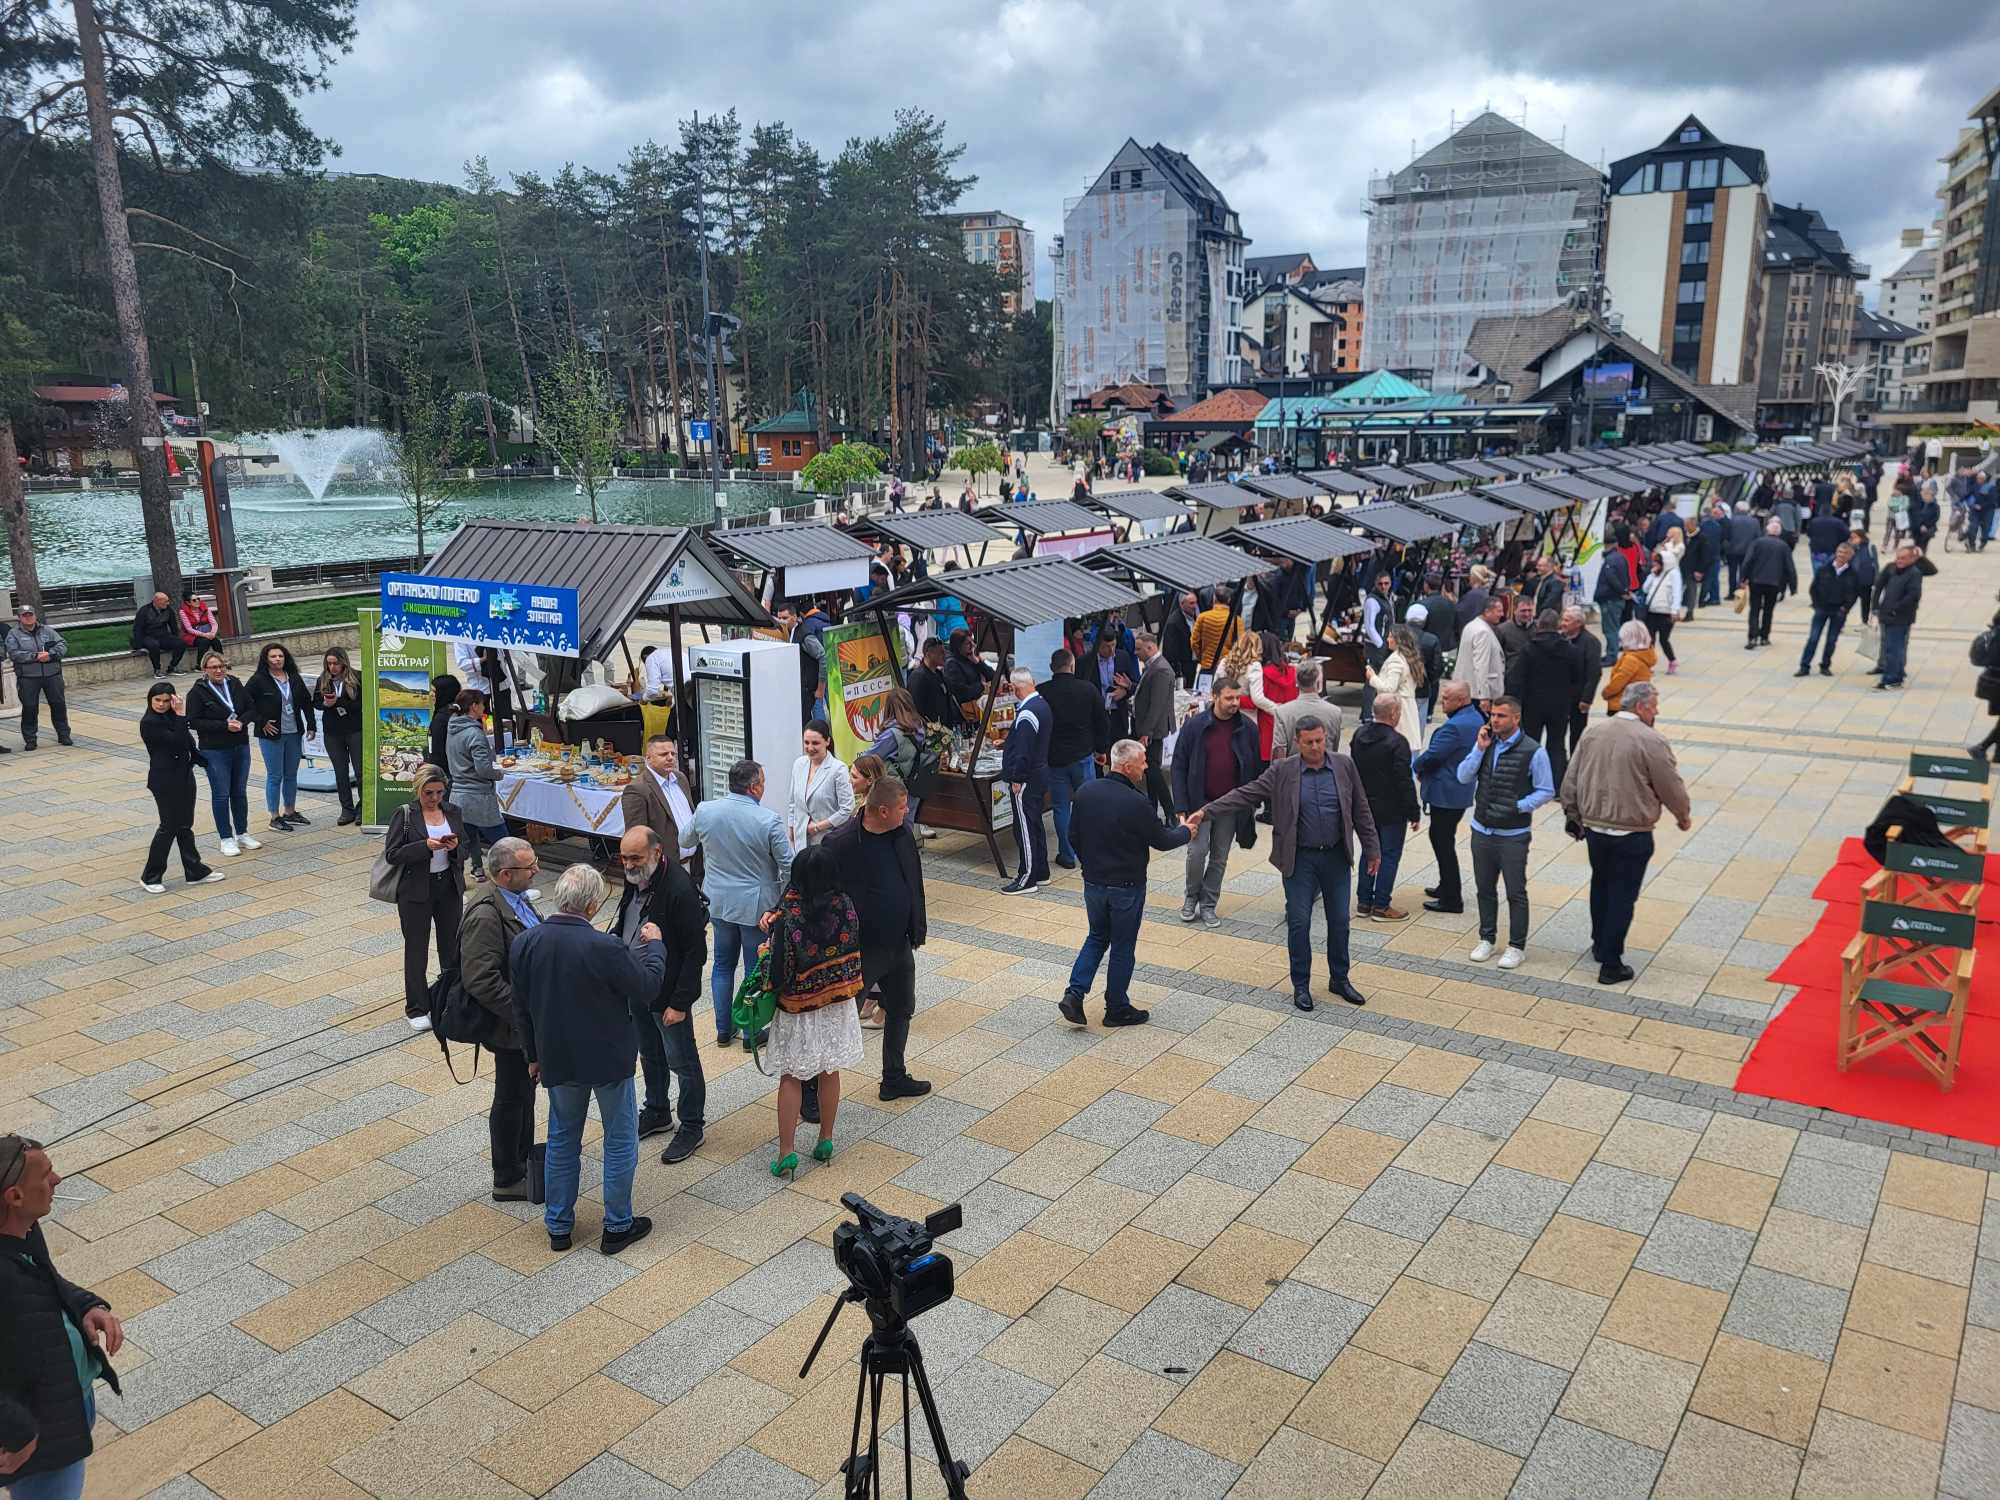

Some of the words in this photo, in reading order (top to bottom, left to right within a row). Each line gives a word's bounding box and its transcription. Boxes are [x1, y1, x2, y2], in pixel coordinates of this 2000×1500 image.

[531, 596, 558, 610] НАША
[527, 610, 563, 625] ЗЛАТКА
[377, 657, 397, 667] ЕКО
[398, 657, 430, 668] АГРАР
